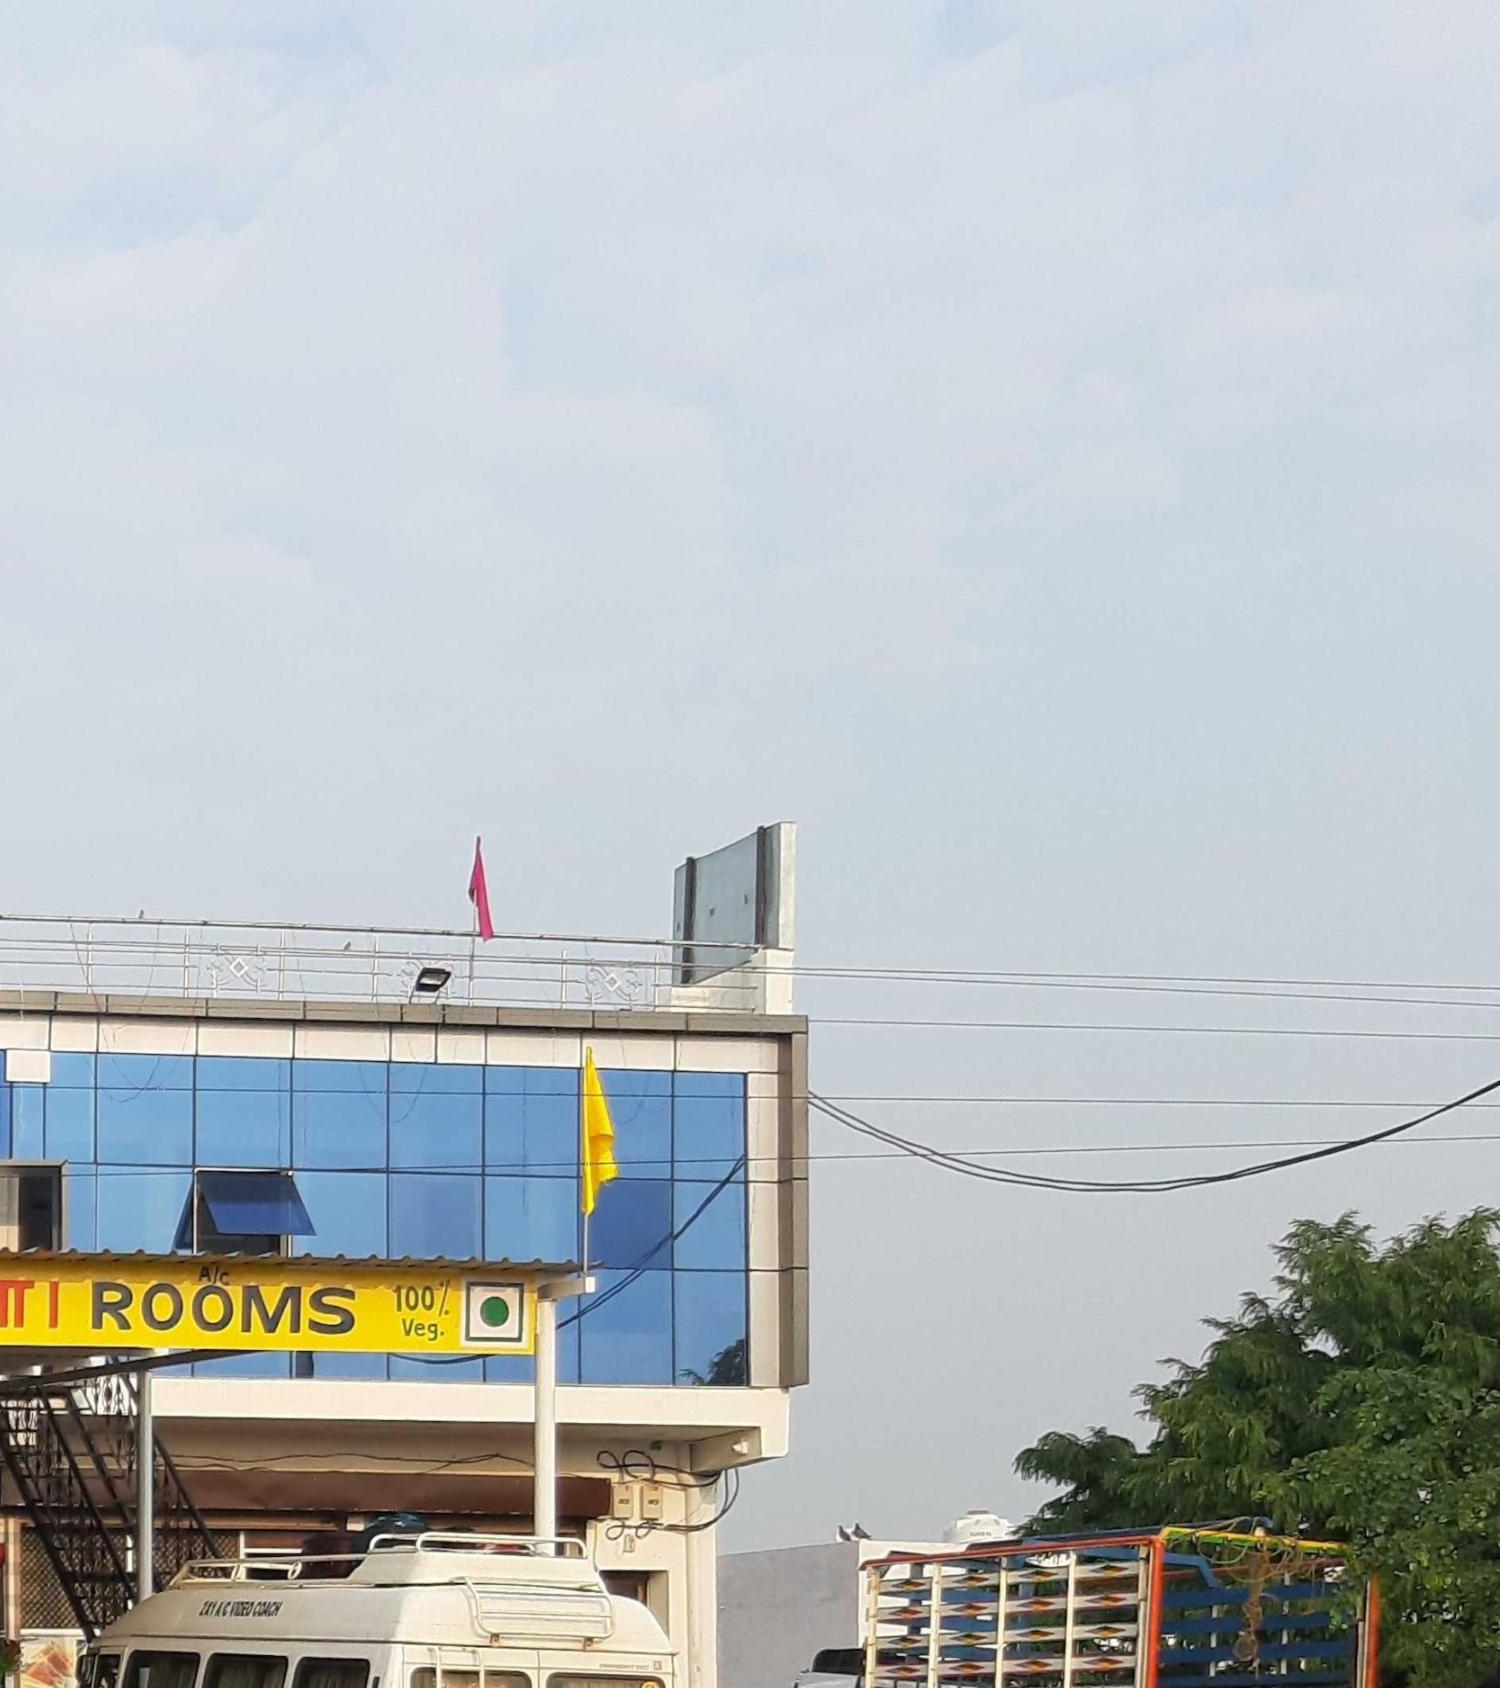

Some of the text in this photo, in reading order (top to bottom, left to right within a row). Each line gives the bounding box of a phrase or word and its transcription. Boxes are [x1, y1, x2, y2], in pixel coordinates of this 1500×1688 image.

[90, 1279, 356, 1335] ROOMS
[392, 1278, 451, 1317] 100%
[401, 1316, 446, 1342] Veg.
